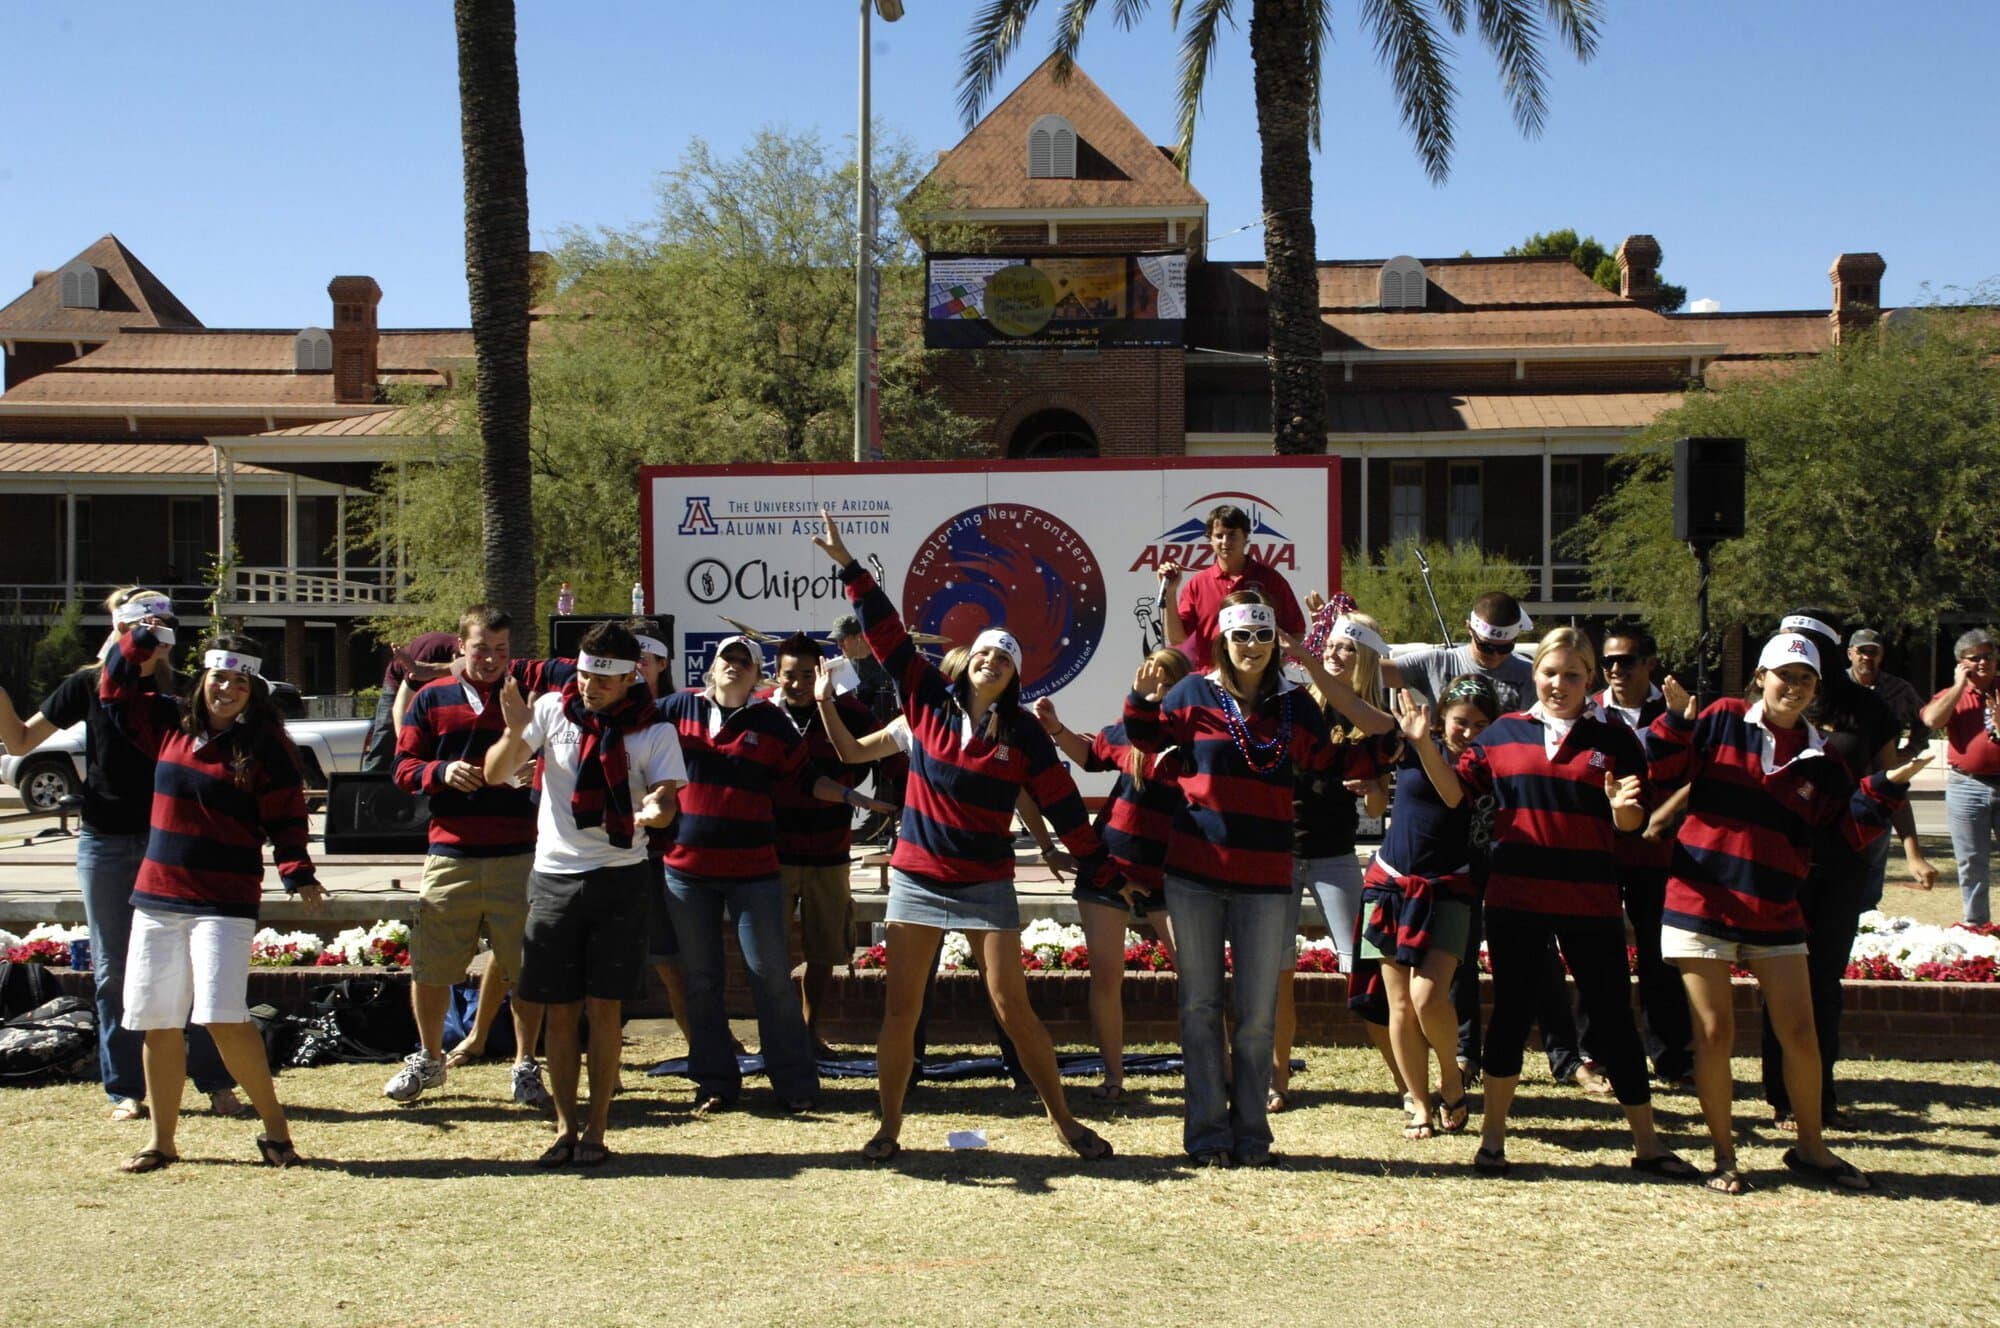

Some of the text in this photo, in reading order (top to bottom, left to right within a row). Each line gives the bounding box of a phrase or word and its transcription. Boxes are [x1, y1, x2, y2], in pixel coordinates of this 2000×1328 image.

[678, 497, 718, 535] A
[729, 499, 891, 513] THE UNIVERSITY OF ARIZONA
[726, 519, 890, 536] ALUMNI ASSOIATION
[912, 508, 1092, 577] Exploring New Frontiers
[1128, 543, 1296, 573] ARIZNA
[1787, 640, 1808, 656] A
[1021, 646, 1092, 700] Alumni Association
